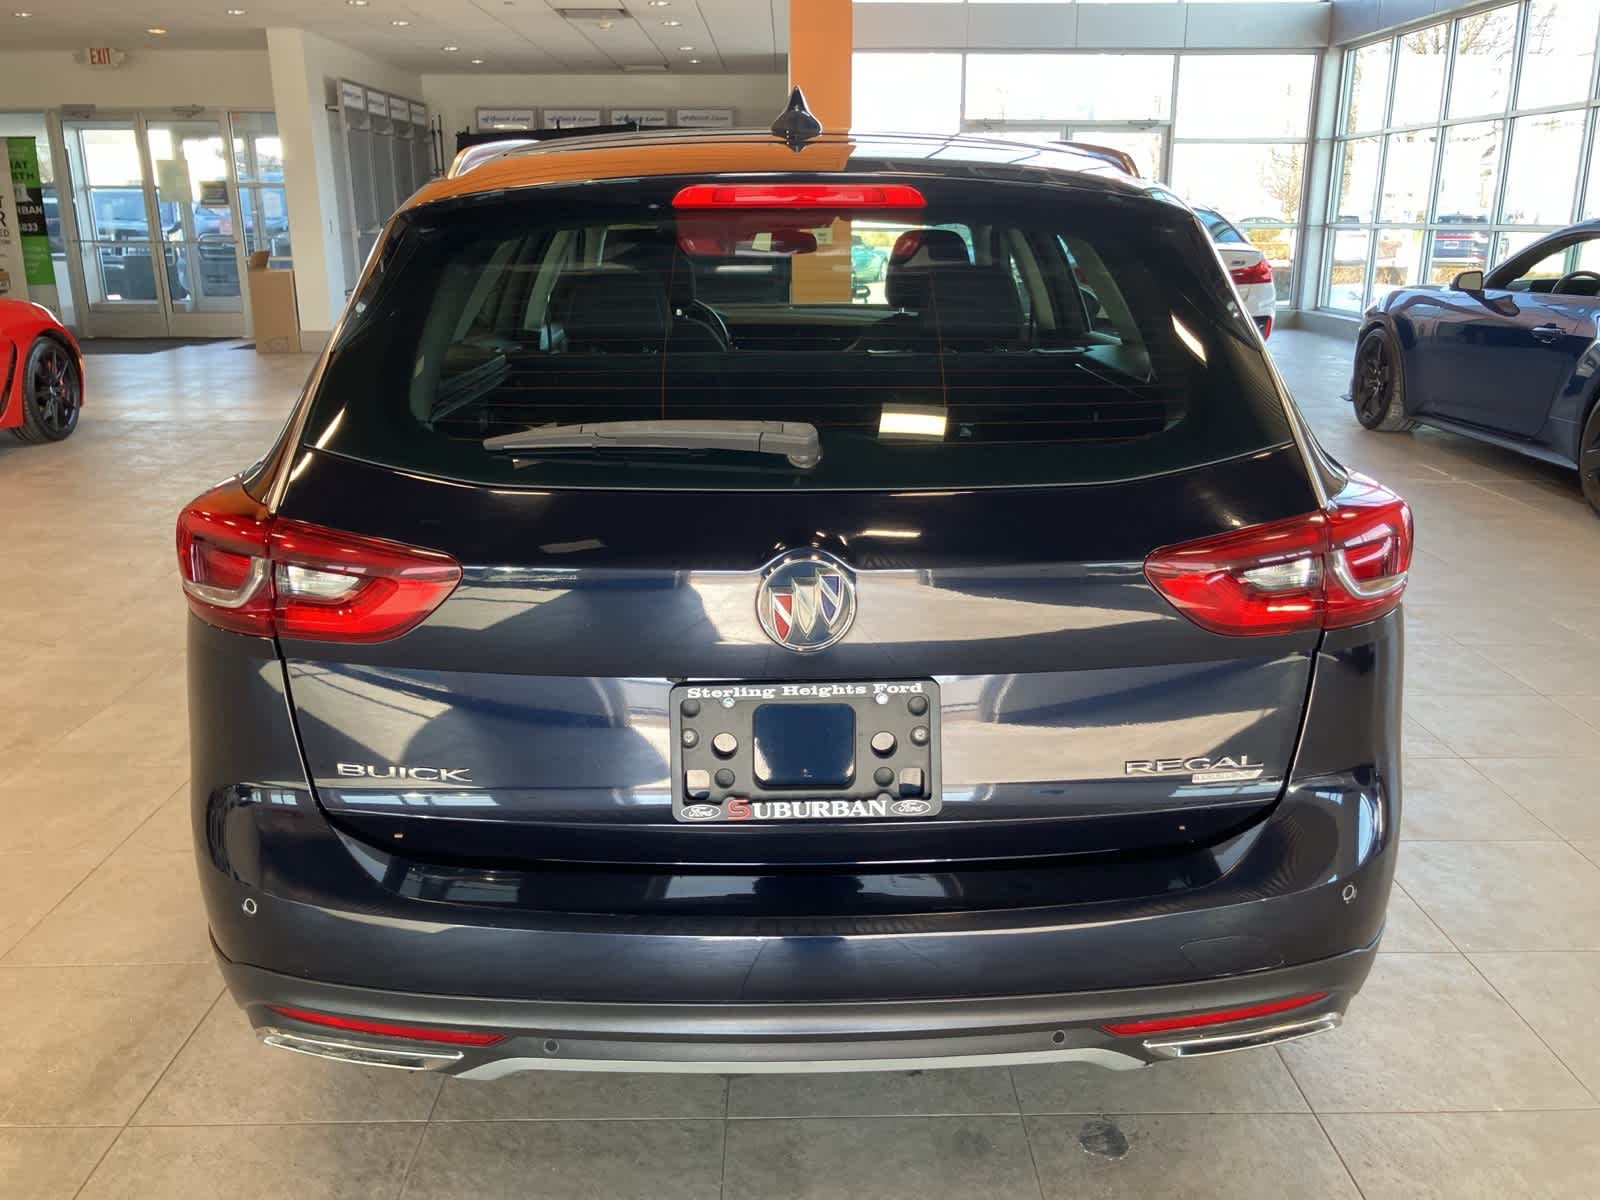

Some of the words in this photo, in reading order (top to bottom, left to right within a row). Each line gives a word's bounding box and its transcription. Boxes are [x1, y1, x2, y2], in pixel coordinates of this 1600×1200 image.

[90, 47, 111, 64] EXIT
[687, 686, 776, 699] Sterling
[782, 684, 867, 698] Heights
[872, 682, 924, 695] Ford
[336, 763, 473, 782] BUICK
[1125, 753, 1264, 775] REGAL
[685, 805, 715, 819] Ford
[727, 798, 887, 820] SUBURBAN
[896, 800, 926, 815] Ford
